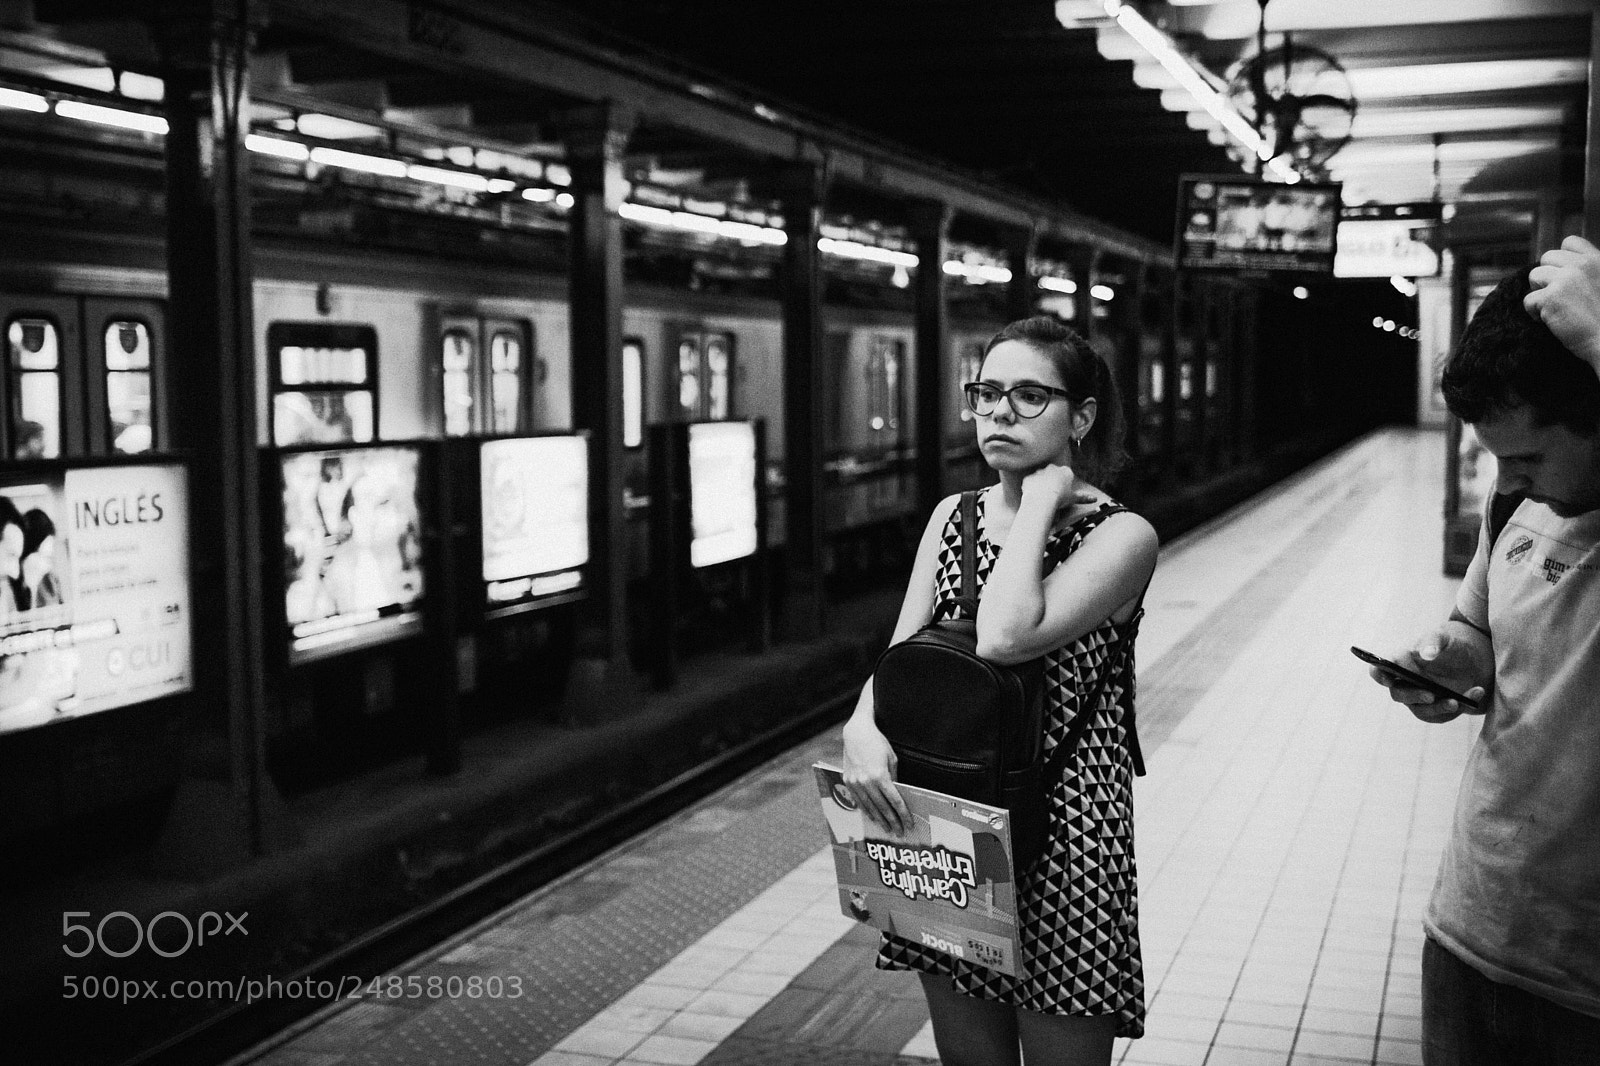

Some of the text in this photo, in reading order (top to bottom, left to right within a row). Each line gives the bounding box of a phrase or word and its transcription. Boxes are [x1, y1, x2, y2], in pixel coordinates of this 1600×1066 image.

[75, 492, 164, 530] INGLÉS
[866, 842, 976, 888] Entretenida
[881, 868, 967, 907] Cartulina
[921, 932, 964, 957] BLOCK
